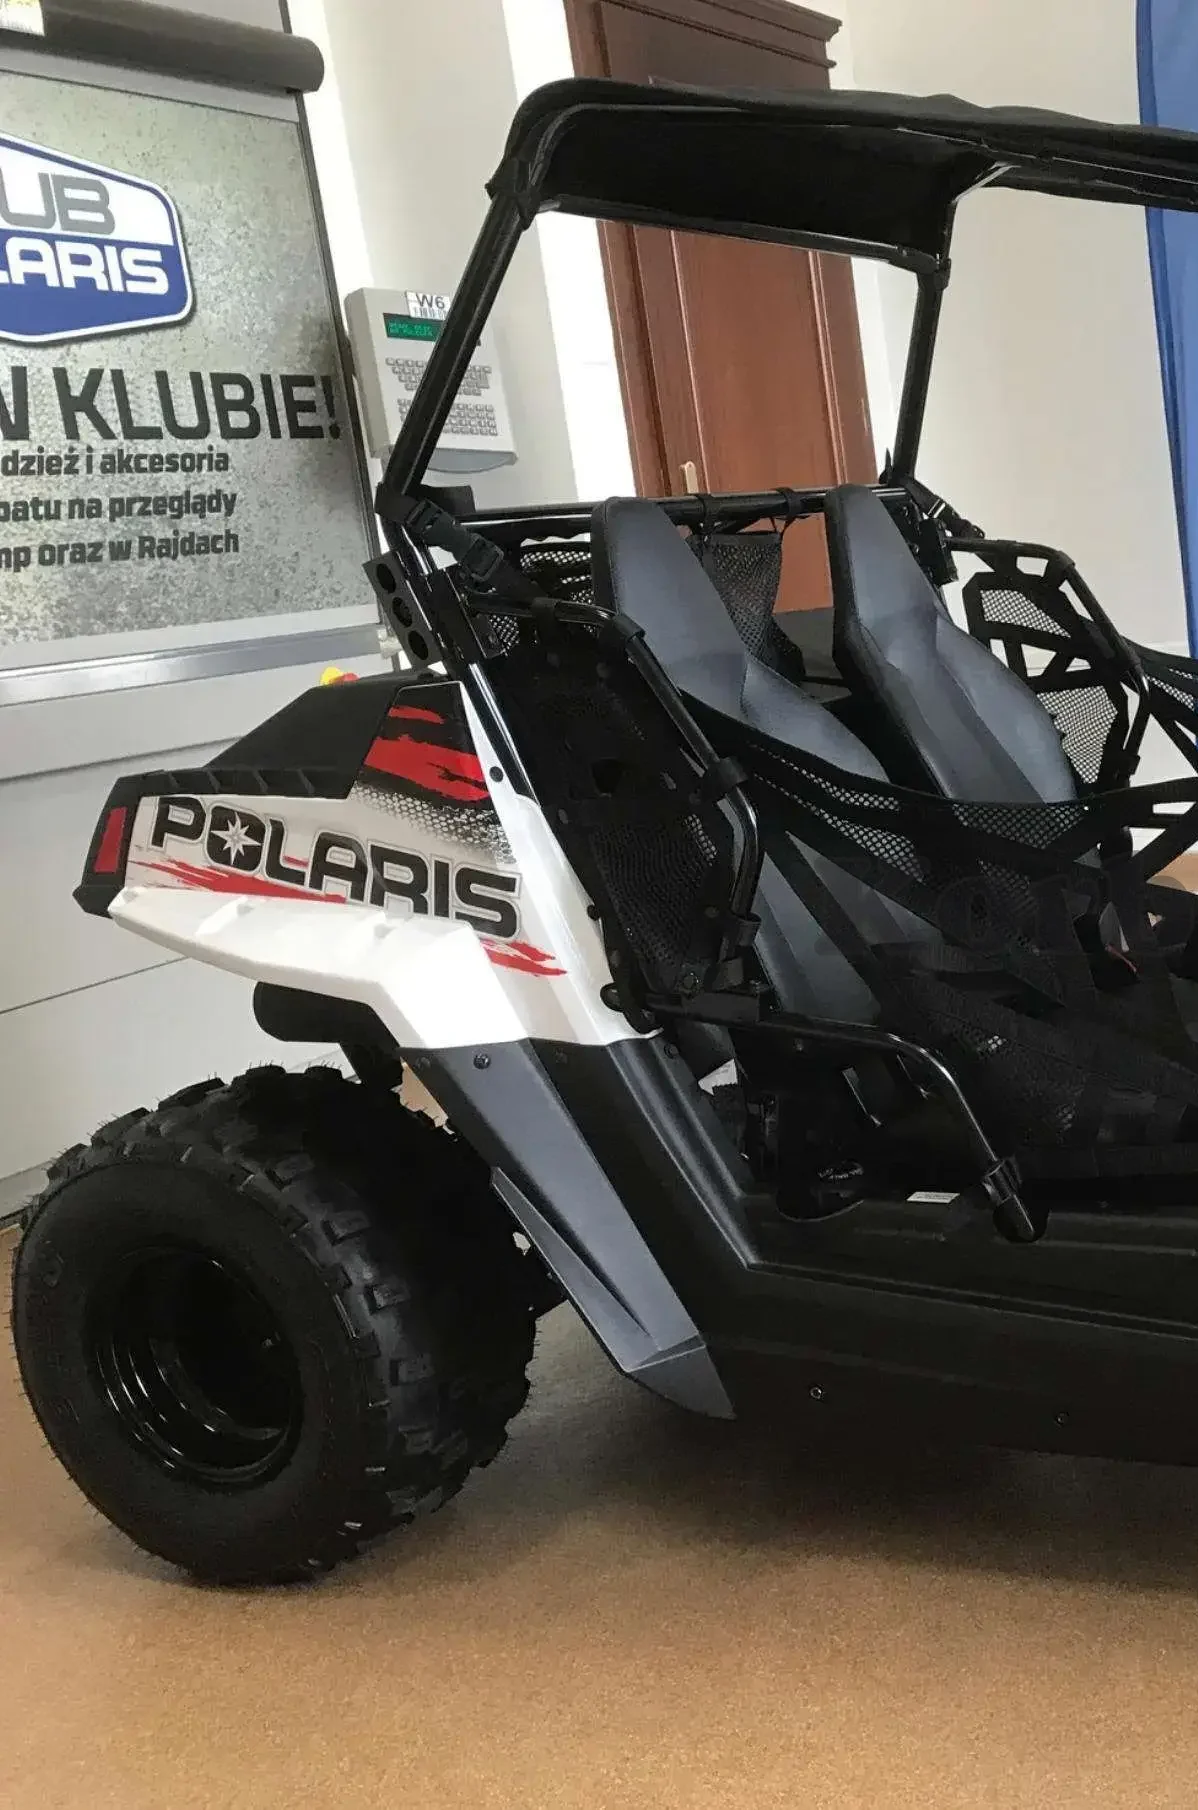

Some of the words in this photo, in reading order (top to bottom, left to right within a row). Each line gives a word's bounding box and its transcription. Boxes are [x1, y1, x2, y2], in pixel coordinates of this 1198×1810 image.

[0, 236, 169, 295] ARIS
[416, 293, 445, 309] W6
[52, 366, 342, 440] KLUBIE!
[86, 444, 93, 474] i
[100, 444, 229, 474] akcesoria
[68, 499, 102, 519] na
[109, 489, 237, 522] przeglądy
[38, 541, 103, 566] oraz
[109, 539, 132, 561] w
[138, 529, 240, 560] Rajdach
[150, 797, 520, 938] POLARIS
